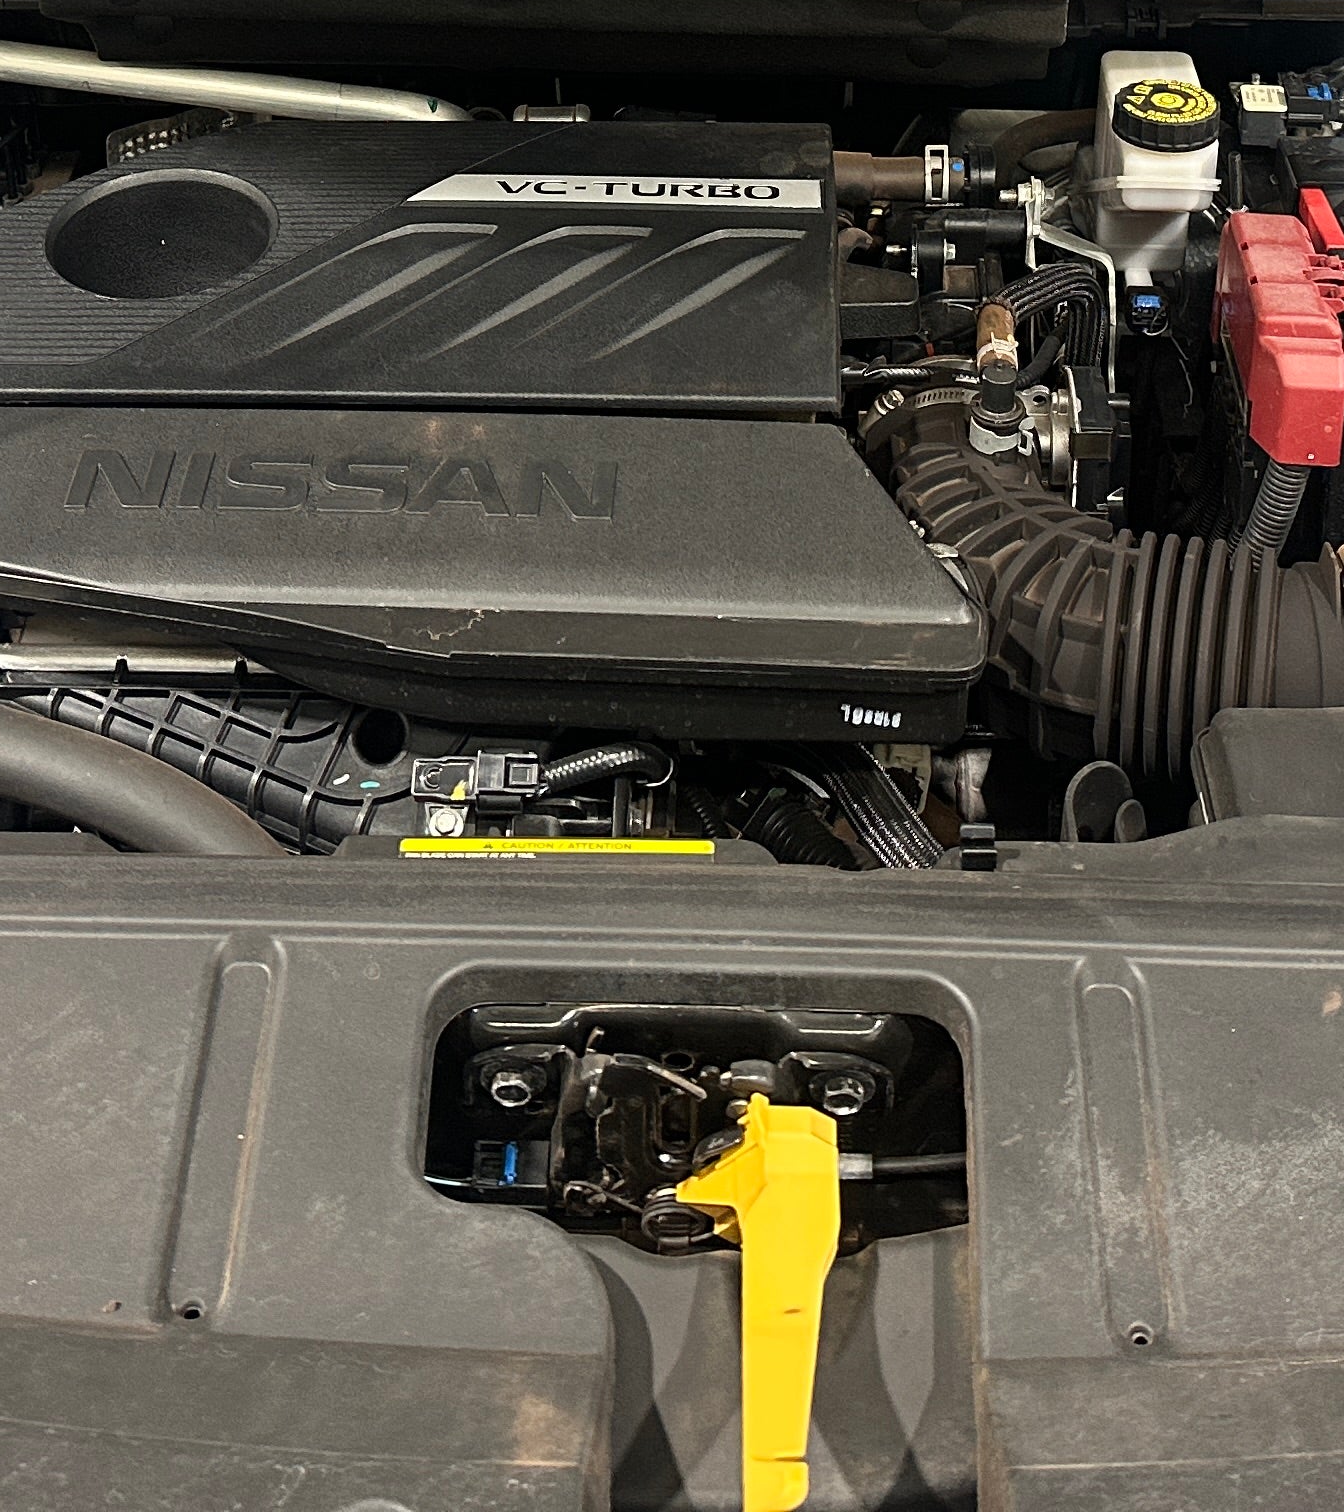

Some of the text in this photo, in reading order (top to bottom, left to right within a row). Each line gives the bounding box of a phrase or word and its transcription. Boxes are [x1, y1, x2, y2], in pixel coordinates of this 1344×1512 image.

[497, 180, 780, 200] VC-TURBO
[63, 448, 618, 521] NISSAN
[567, 842, 632, 850] ATTENTION
